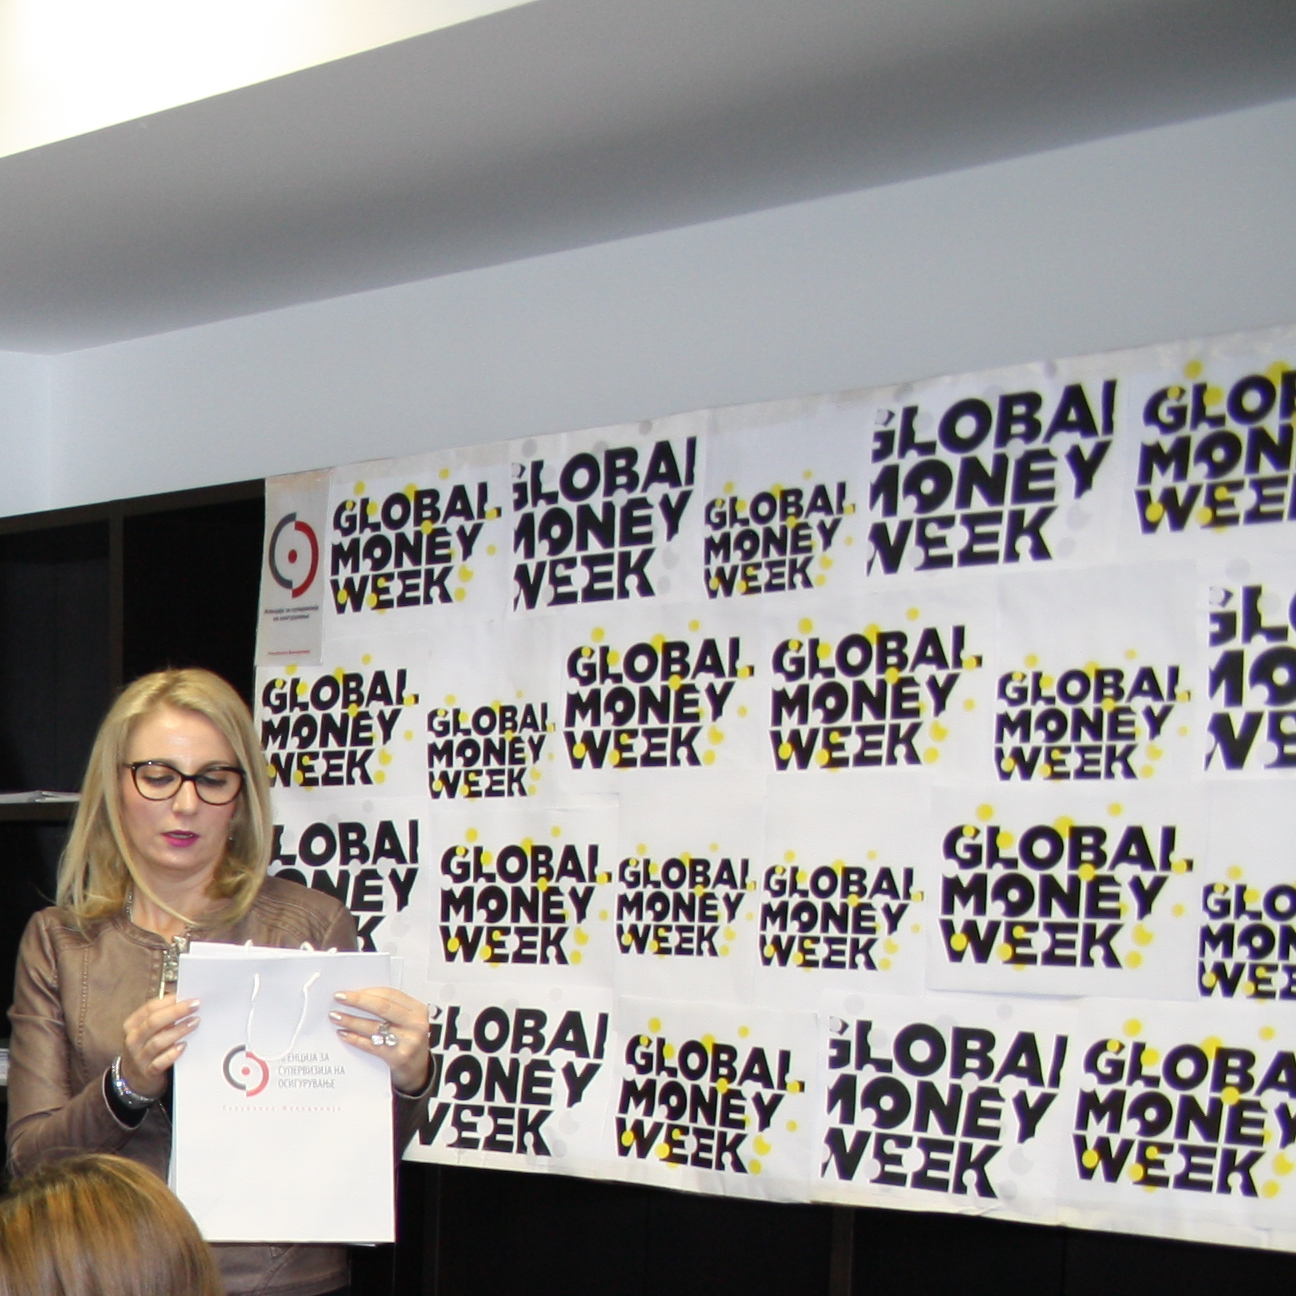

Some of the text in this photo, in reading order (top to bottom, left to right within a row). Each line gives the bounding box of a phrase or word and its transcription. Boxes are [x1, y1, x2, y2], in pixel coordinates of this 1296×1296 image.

[330, 522, 484, 578] MONEY
[704, 517, 842, 565] MONEY
[330, 566, 453, 614] WEEK
[704, 556, 813, 599] WEEK
[565, 681, 735, 728] MONEY
[772, 673, 960, 727] MONEY
[261, 708, 402, 751] MONEY
[997, 705, 1173, 743] MONEY
[428, 734, 546, 769] MONEY
[564, 726, 702, 769] WEEK
[769, 722, 922, 770] WEEK
[997, 744, 1137, 780] WEEK
[429, 767, 527, 799] WEEK
[441, 885, 595, 924] MONEY
[617, 890, 745, 923] MONEY
[761, 900, 909, 935] MONEY
[942, 872, 1168, 920] MONEY
[440, 925, 569, 965] WEEK
[616, 923, 719, 957] WEEK
[760, 934, 877, 970] WEEK
[941, 919, 1123, 968] WEEK
[334, 1065, 346, 1075] НА
[619, 1078, 784, 1132] MONEY
[616, 1117, 748, 1174] WEEK
[1075, 1134, 1265, 1197] WEEK
